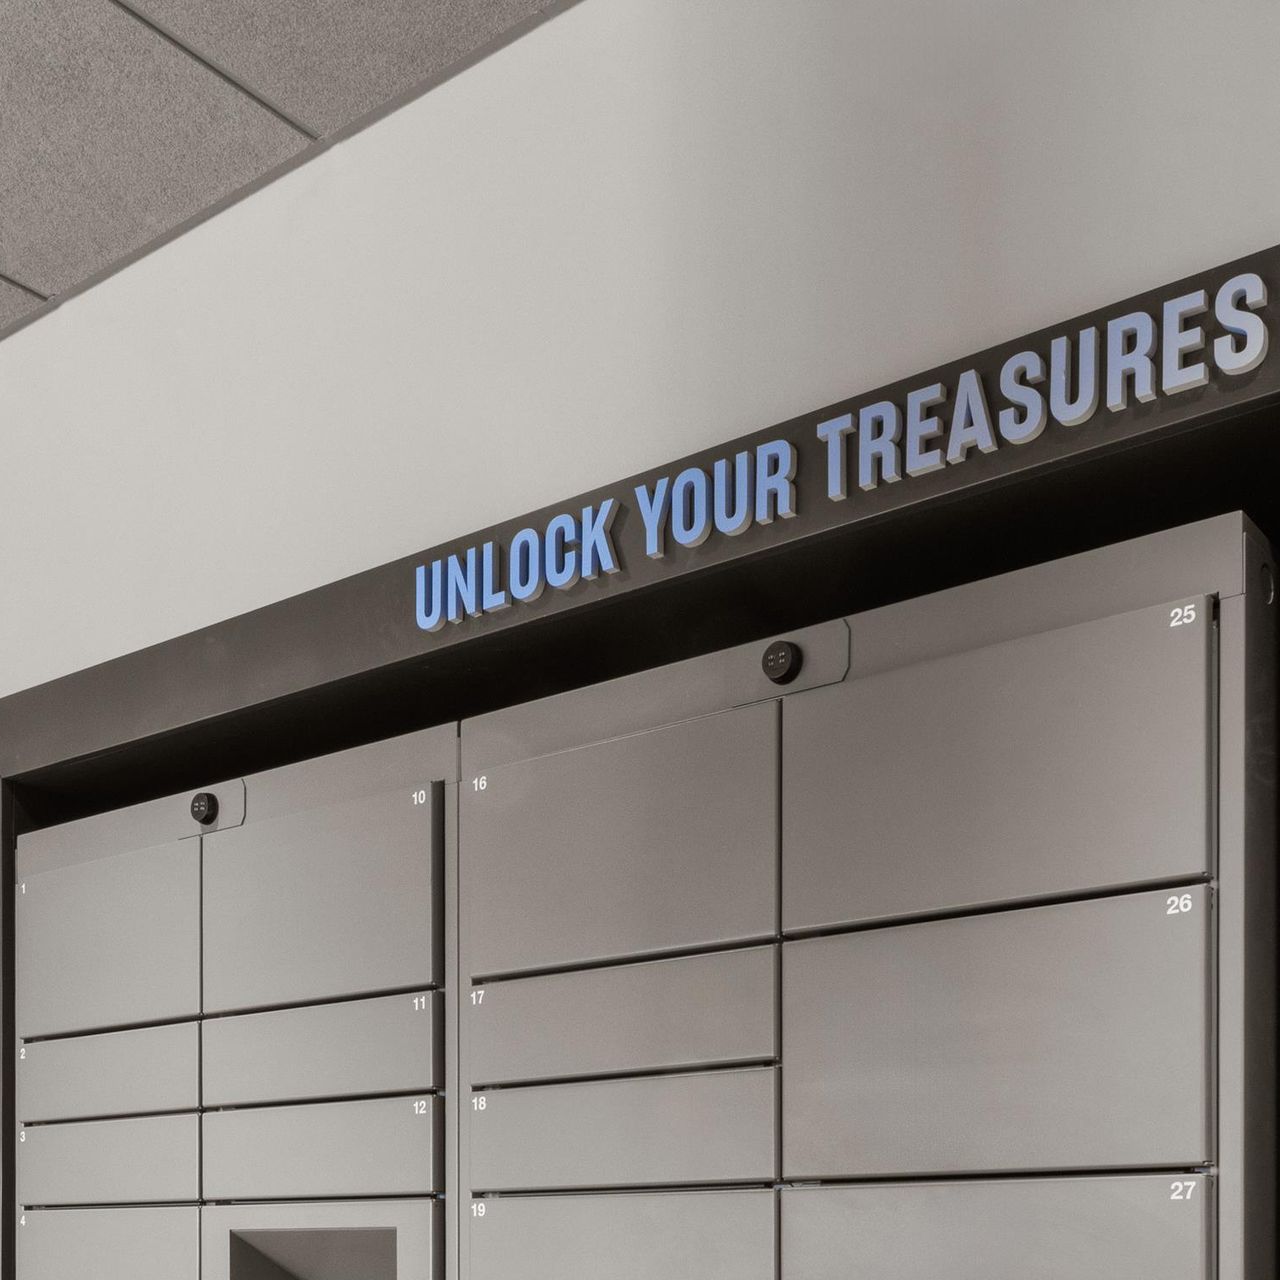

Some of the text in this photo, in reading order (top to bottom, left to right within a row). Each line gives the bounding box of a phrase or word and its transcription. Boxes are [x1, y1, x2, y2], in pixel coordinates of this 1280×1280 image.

[414, 272, 1269, 632] UNLOCK YOUR TREASURES
[1168, 603, 1197, 628] 25
[472, 775, 487, 792] 16
[412, 790, 426, 805] 10
[21, 883, 26, 894] 1
[1166, 893, 1193, 915] 26
[413, 995, 426, 1011] 11
[470, 990, 485, 1005] 17
[20, 1047, 26, 1060] 2
[413, 1100, 427, 1115] 12
[471, 1096, 487, 1111] 18
[20, 1131, 26, 1143] 3
[1170, 1181, 1196, 1200] 27
[471, 1202, 486, 1217] 19
[20, 1215, 26, 1226] 4
